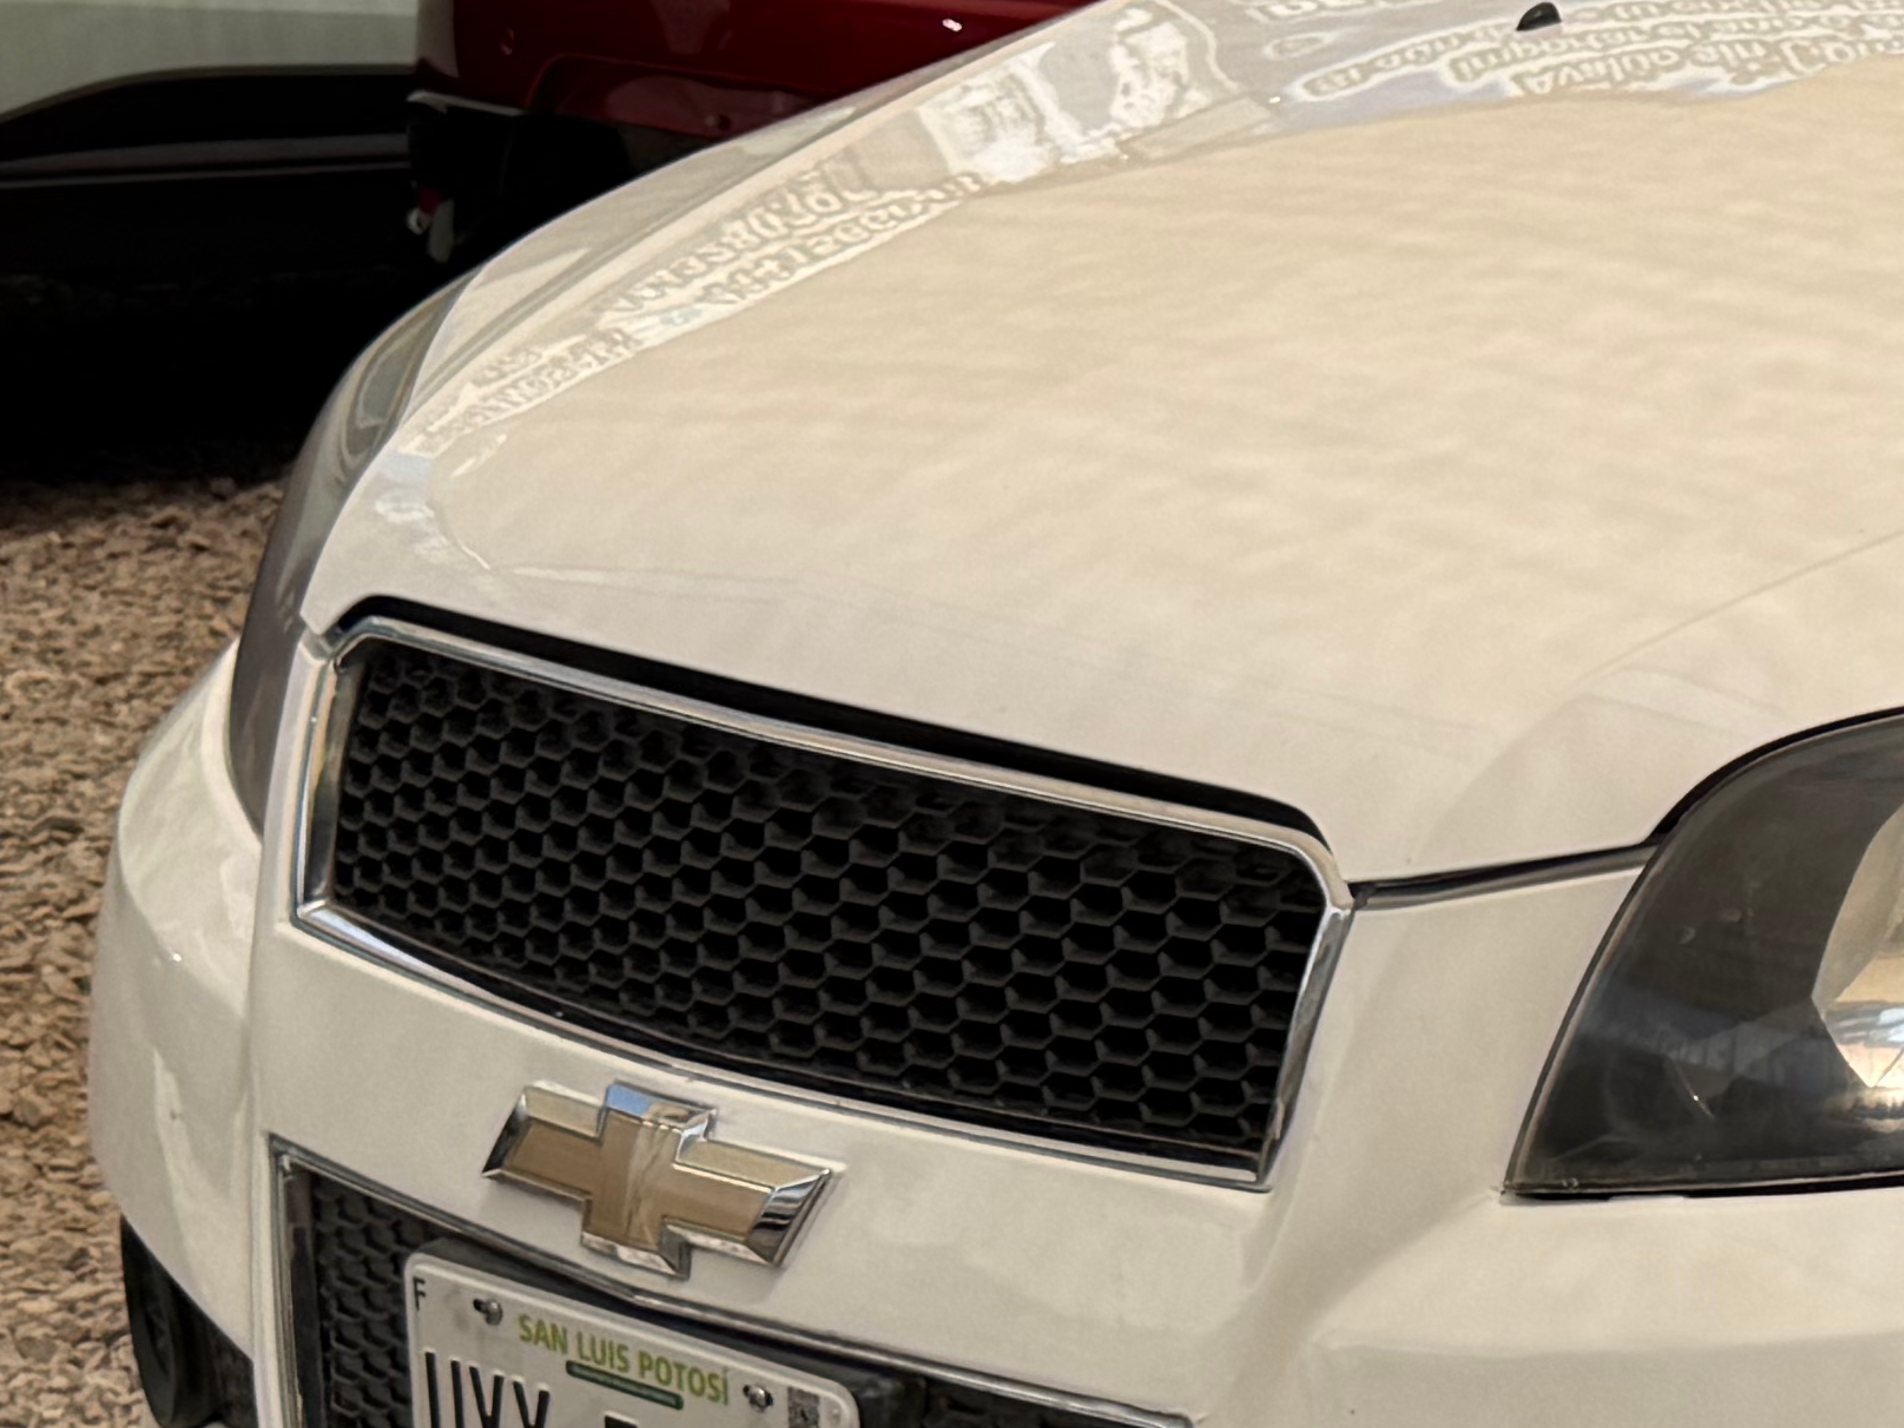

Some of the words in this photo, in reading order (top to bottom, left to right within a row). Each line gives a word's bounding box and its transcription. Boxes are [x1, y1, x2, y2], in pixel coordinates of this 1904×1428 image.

[517, 1314, 569, 1354] SAN
[576, 1332, 630, 1373] LUIS
[637, 1349, 731, 1406] POTOSÍ
